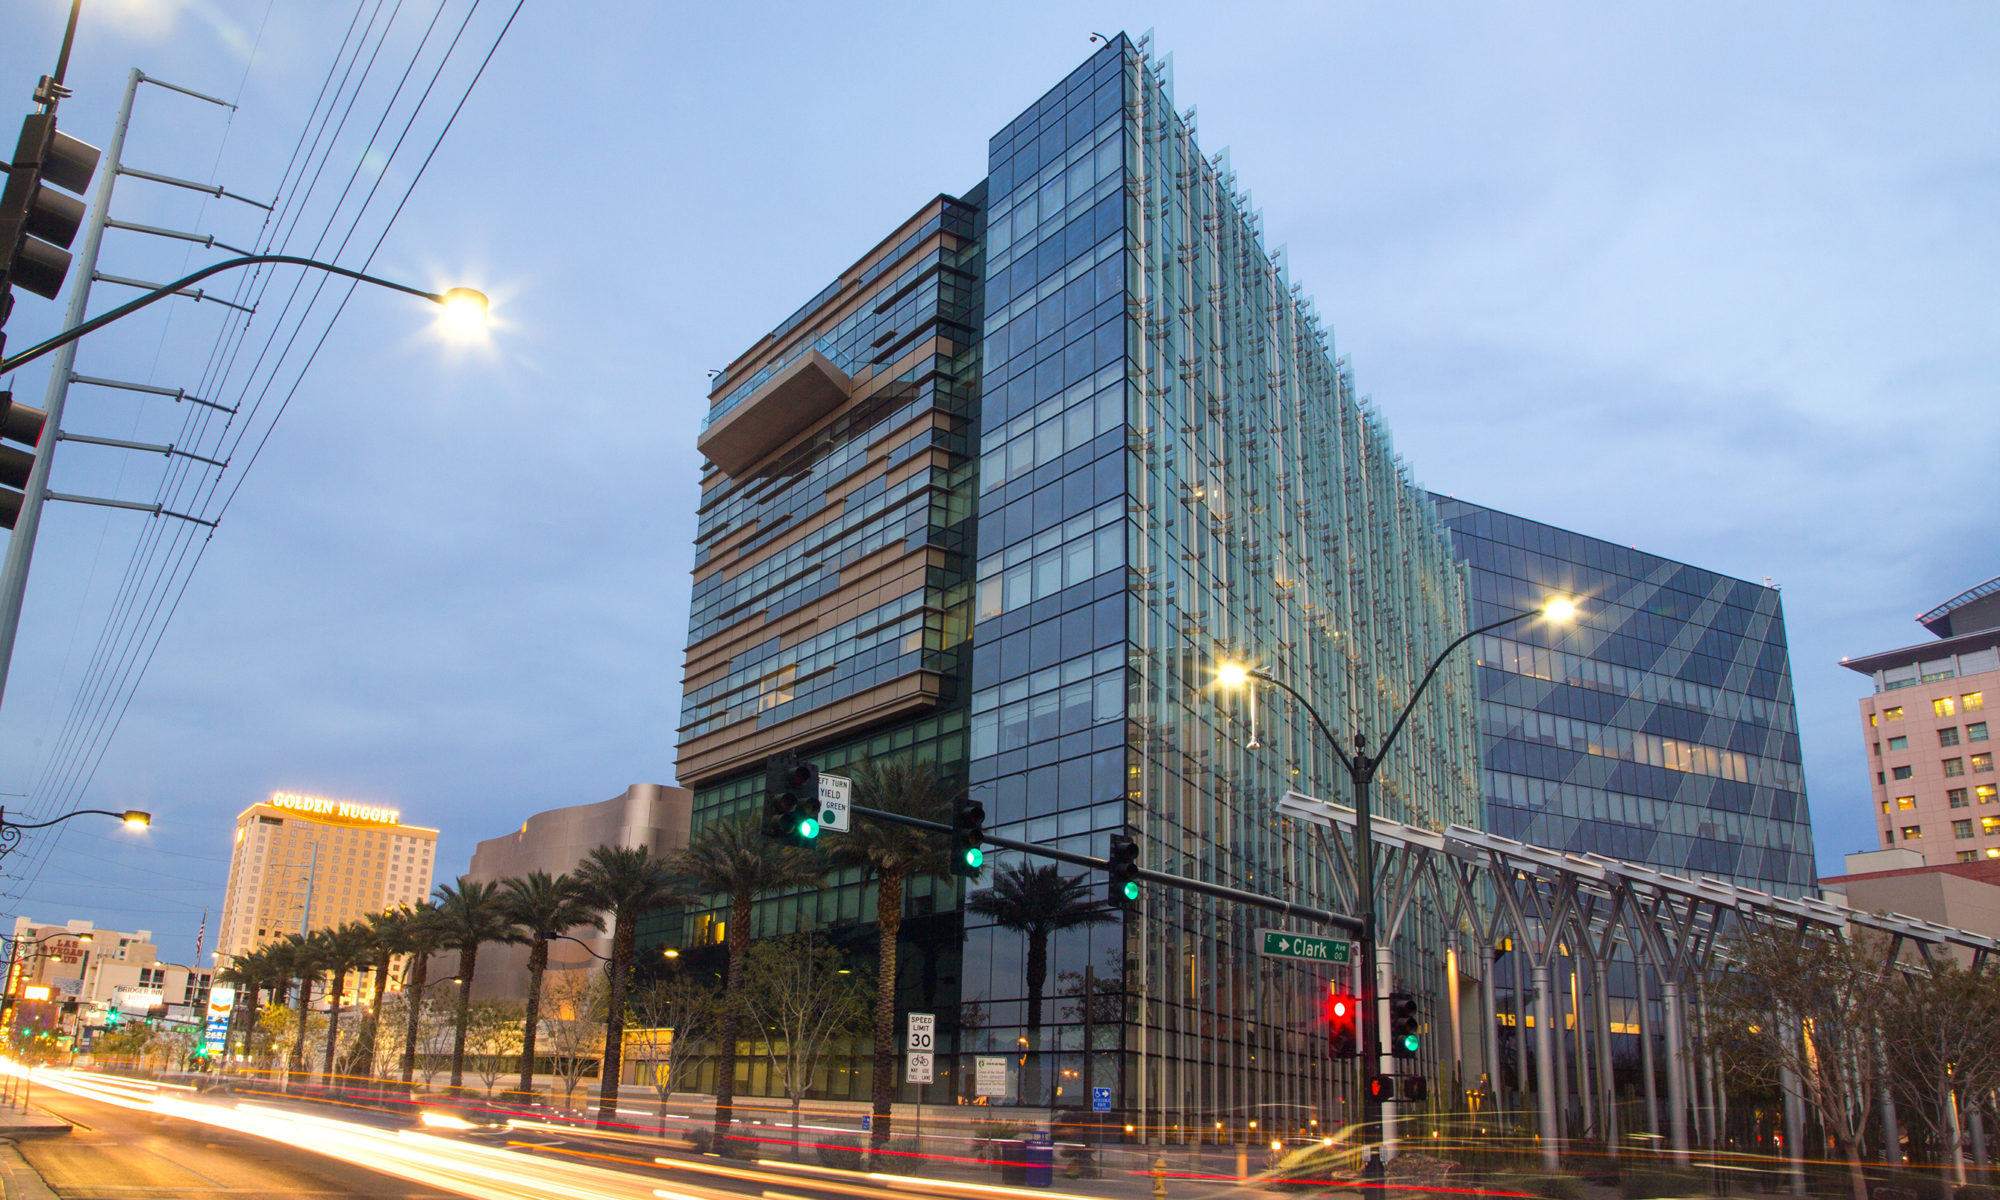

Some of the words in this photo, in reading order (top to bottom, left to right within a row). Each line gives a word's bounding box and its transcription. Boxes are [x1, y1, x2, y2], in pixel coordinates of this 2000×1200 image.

[832, 780, 847, 788] TURN
[820, 789, 841, 799] YIELD
[273, 793, 334, 815] GOLDEN
[338, 803, 399, 825] NUGGET
[826, 802, 846, 810] GREEN
[57, 940, 79, 948] LAS
[1267, 934, 1272, 943] E
[1293, 938, 1327, 958] Clark
[1335, 943, 1346, 952] Ave
[50, 946, 84, 956] VEGAS
[1334, 952, 1343, 960] 00
[911, 1016, 933, 1024] SPEED
[913, 1024, 930, 1032] LIMIT
[911, 1033, 931, 1047] 30
